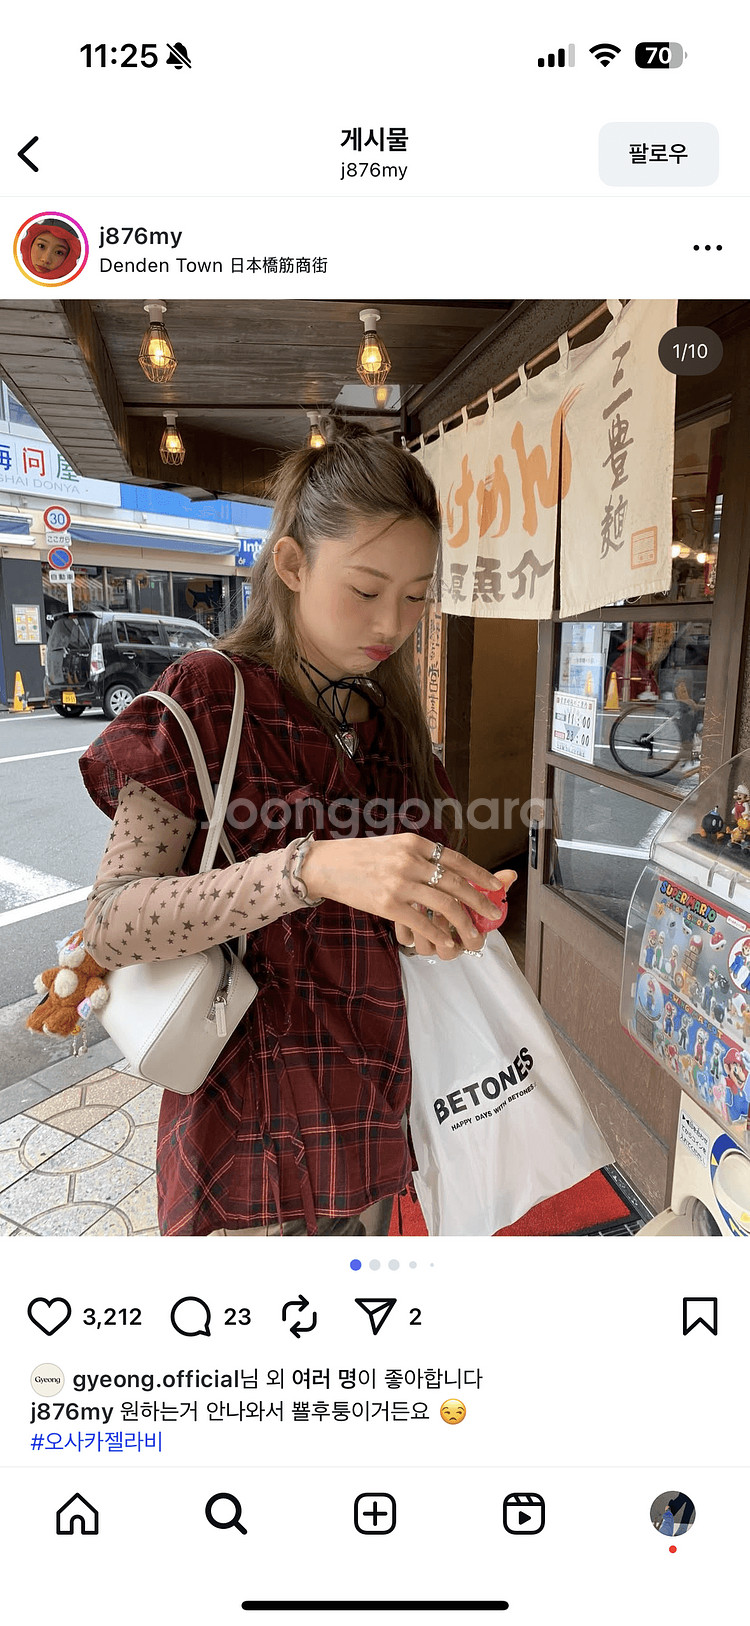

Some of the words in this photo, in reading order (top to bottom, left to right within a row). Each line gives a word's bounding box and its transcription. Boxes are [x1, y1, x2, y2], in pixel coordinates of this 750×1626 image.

[80, 43, 159, 69] 11:25
[645, 46, 672, 64] 70
[341, 127, 409, 152] 게시물
[629, 143, 689, 165] 팔로우
[341, 162, 408, 181] j876my
[98, 227, 183, 249] j876my
[100, 257, 169, 273] Denden
[176, 257, 223, 273] Town
[231, 256, 328, 274] 日本橋筋商街
[437, 383, 585, 548] けめん
[33, 480, 80, 494] DONYA
[49, 513, 66, 526] 30
[47, 535, 71, 544] ここから
[50, 573, 73, 581] 自動車
[567, 713, 591, 730] 11:00
[566, 730, 590, 747] 23:00
[660, 880, 688, 905] SUPER
[686, 896, 717, 922] MARIO
[433, 1047, 534, 1125] BETONES
[451, 1118, 472, 1131] HAPPY
[475, 1111, 493, 1122] DAYS
[493, 1100, 508, 1114] WITH
[82, 1307, 142, 1330] 3,212
[224, 1307, 252, 1326] 23
[409, 1307, 422, 1326] 2
[72, 1368, 258, 1392] gyeong.official님
[266, 1368, 284, 1390] 외
[292, 1367, 330, 1390] 여러
[338, 1367, 377, 1390] 명이
[384, 1367, 484, 1390] 좋아합니다
[30, 1401, 114, 1425] j876my
[120, 1400, 197, 1422] 원하는거
[206, 1400, 283, 1422] 안나와서
[30, 1431, 162, 1453] #오사카젤라비
